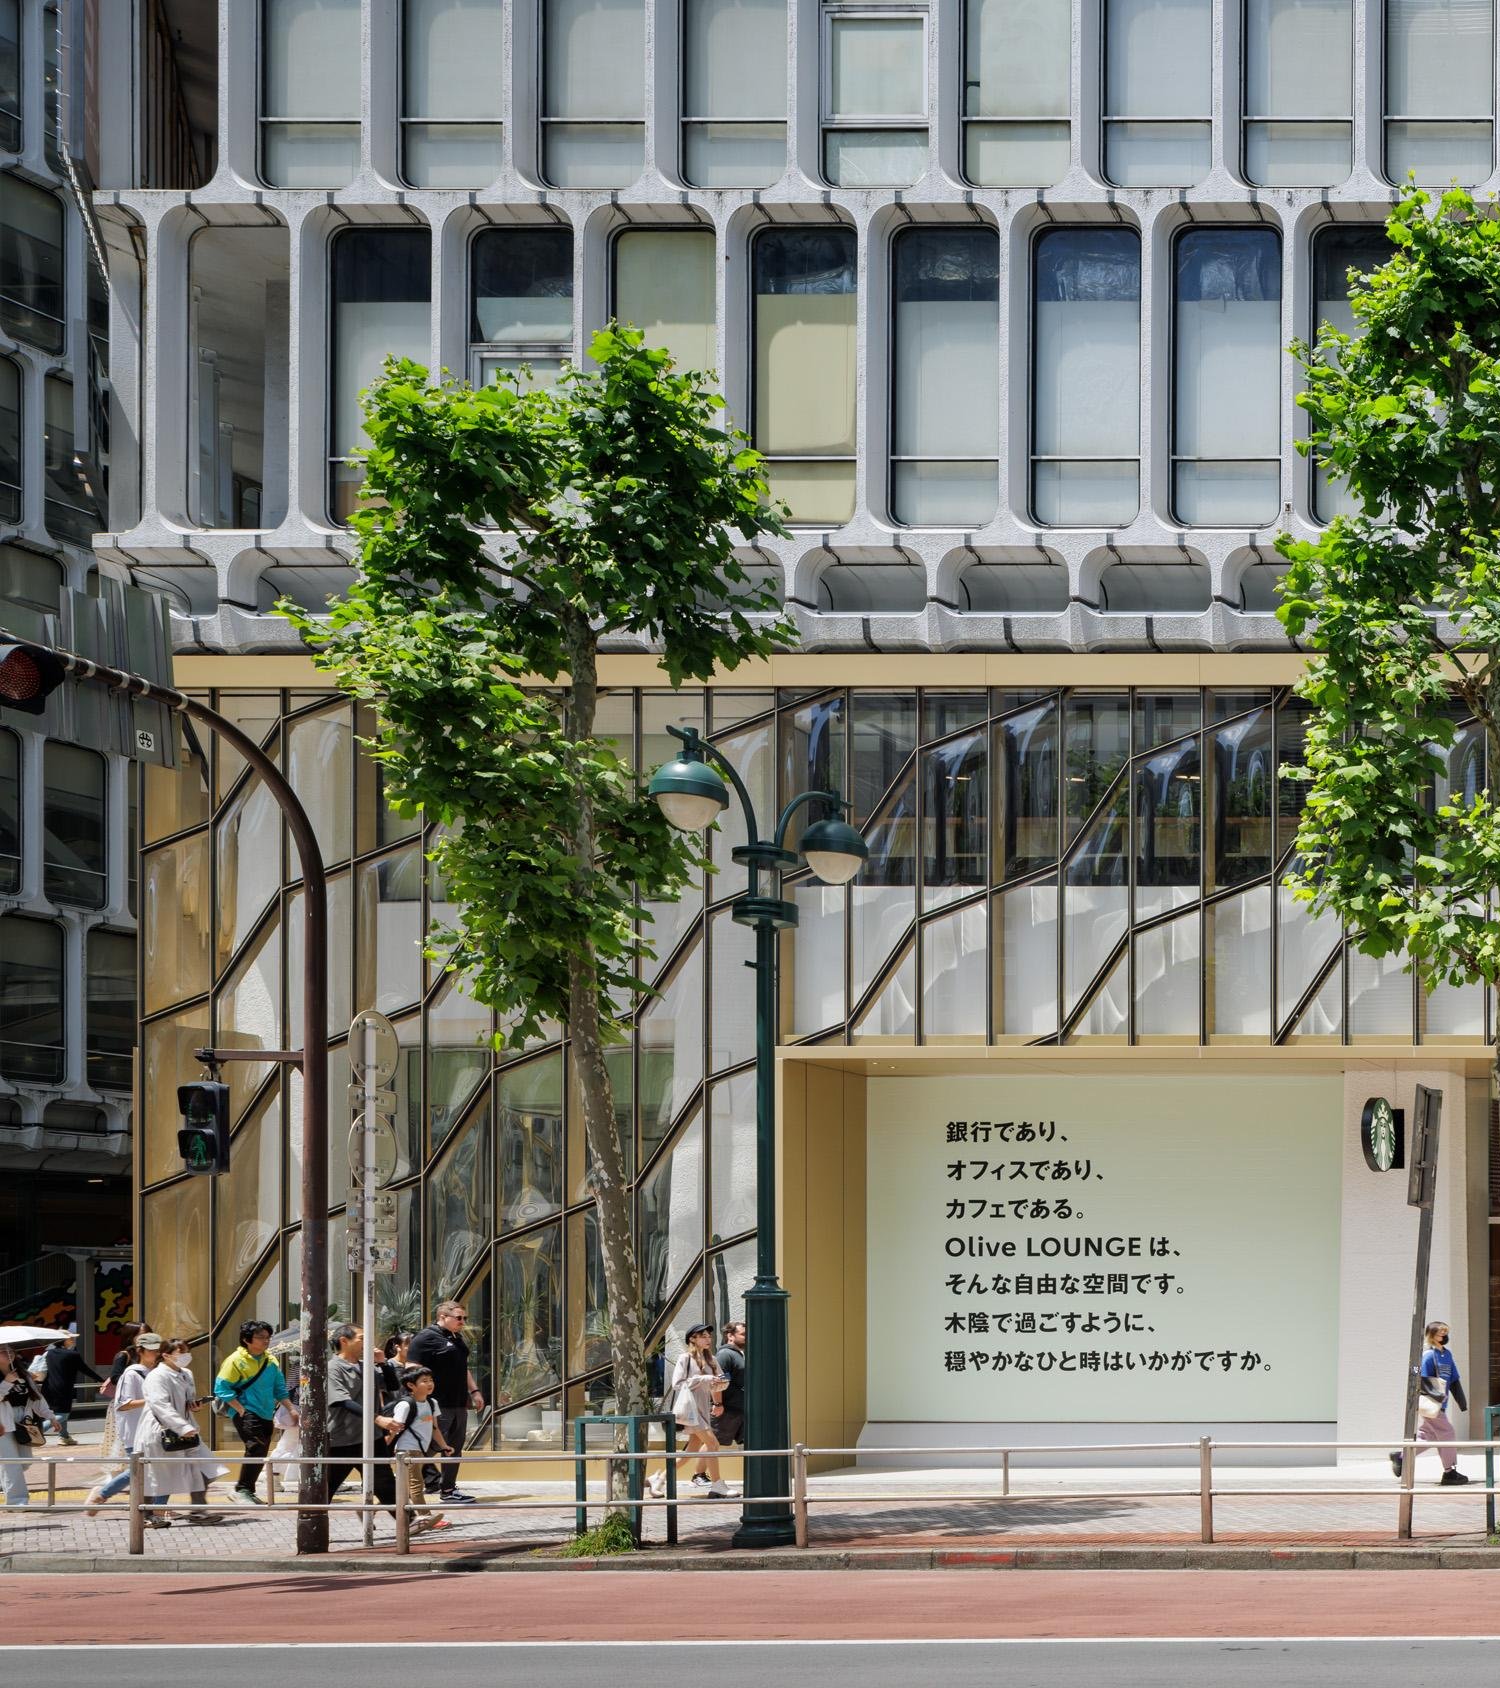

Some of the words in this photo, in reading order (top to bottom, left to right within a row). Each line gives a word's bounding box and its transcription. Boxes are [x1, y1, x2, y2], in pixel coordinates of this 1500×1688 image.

[945, 1120, 1070, 1144] 銀行であり、
[945, 1159, 1105, 1182] オフィスであり、
[945, 1198, 1086, 1220] カフェである。
[944, 1235, 1017, 1258] Olive
[1025, 1236, 1142, 1258] LOUNGE
[1149, 1236, 1183, 1258] は、
[944, 1272, 1186, 1296] そんな自由な空間です。
[944, 1311, 1157, 1334] 木陰で過ごすように、
[944, 1350, 1273, 1373] 穏やかなひと時はいかがですか。
